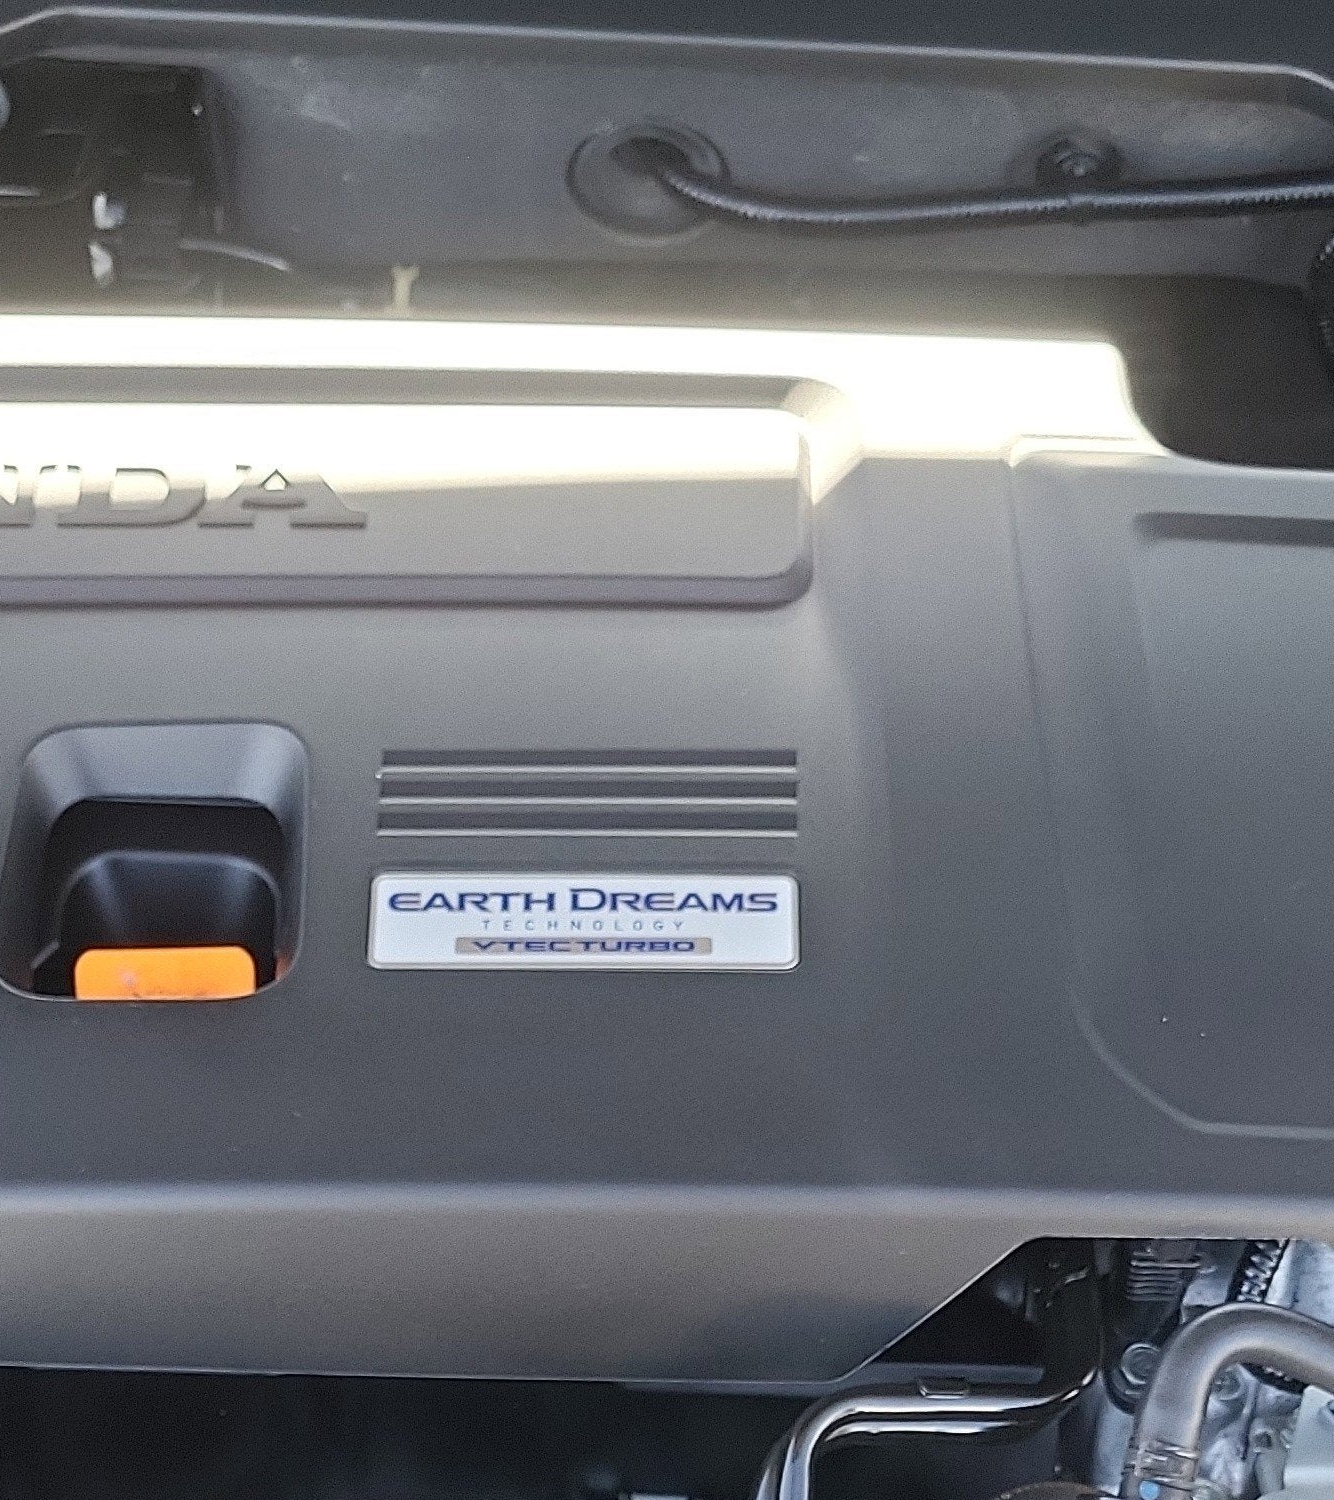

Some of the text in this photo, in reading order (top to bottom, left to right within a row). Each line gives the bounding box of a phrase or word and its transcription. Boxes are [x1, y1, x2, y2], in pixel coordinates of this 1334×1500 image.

[388, 888, 778, 913] EARTH DREAMS
[481, 920, 685, 932] TECHNOLOGY
[473, 940, 695, 952] VTEC TURBO
